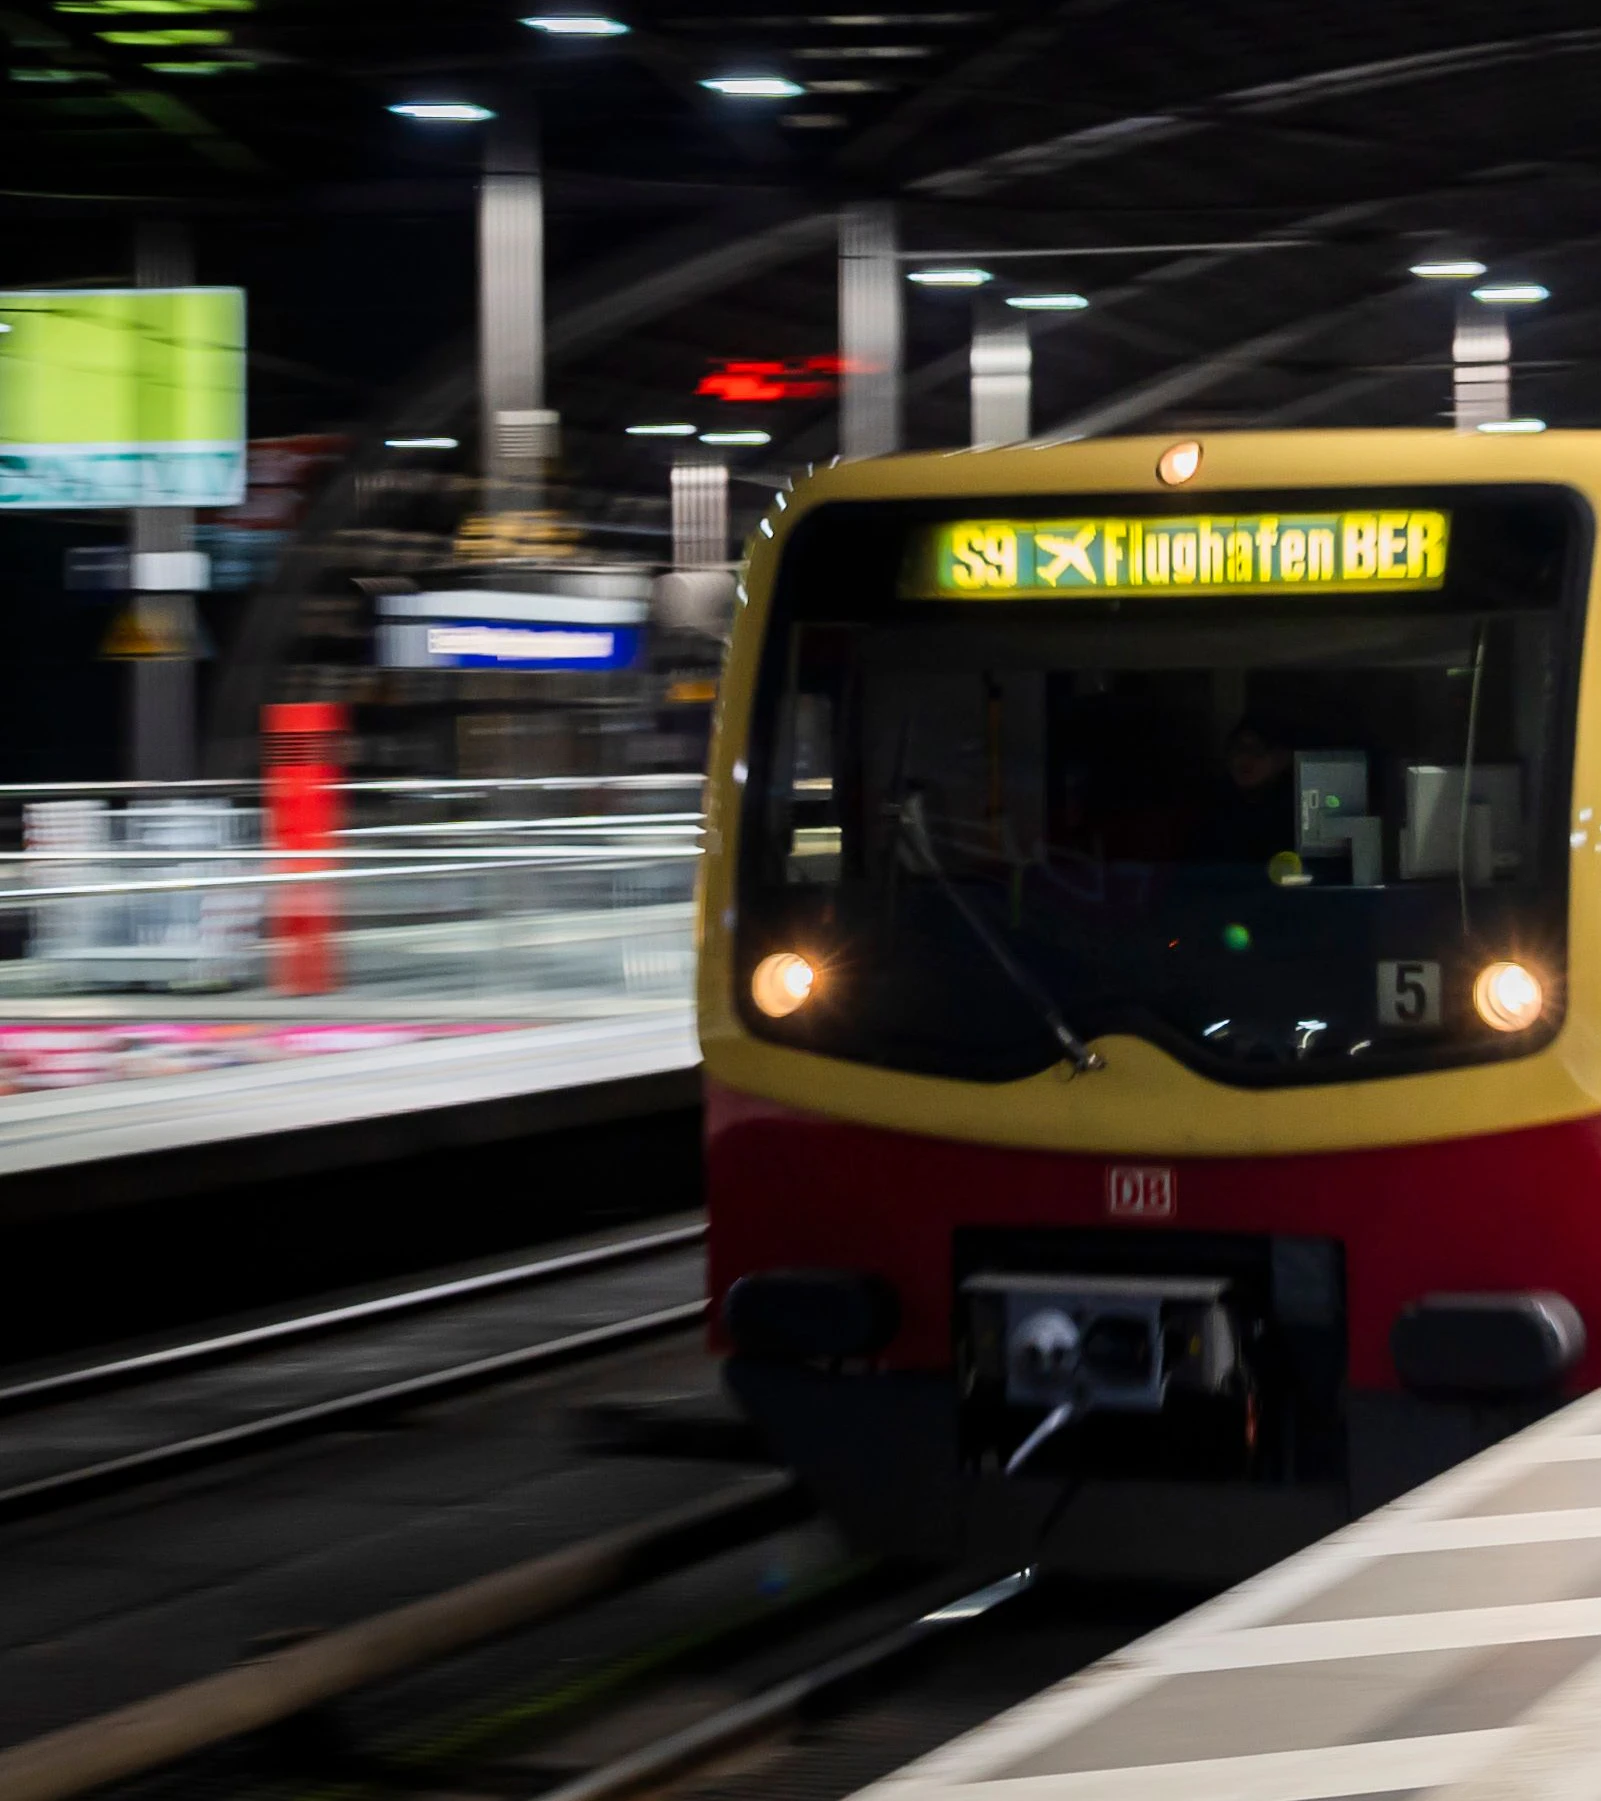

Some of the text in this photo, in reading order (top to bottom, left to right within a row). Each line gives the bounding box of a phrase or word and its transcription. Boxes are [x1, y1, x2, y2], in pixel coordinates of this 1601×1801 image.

[951, 509, 1447, 589] S9 Flughafen BER
[1394, 962, 1427, 1023] 5
[1113, 1171, 1169, 1211] DB
